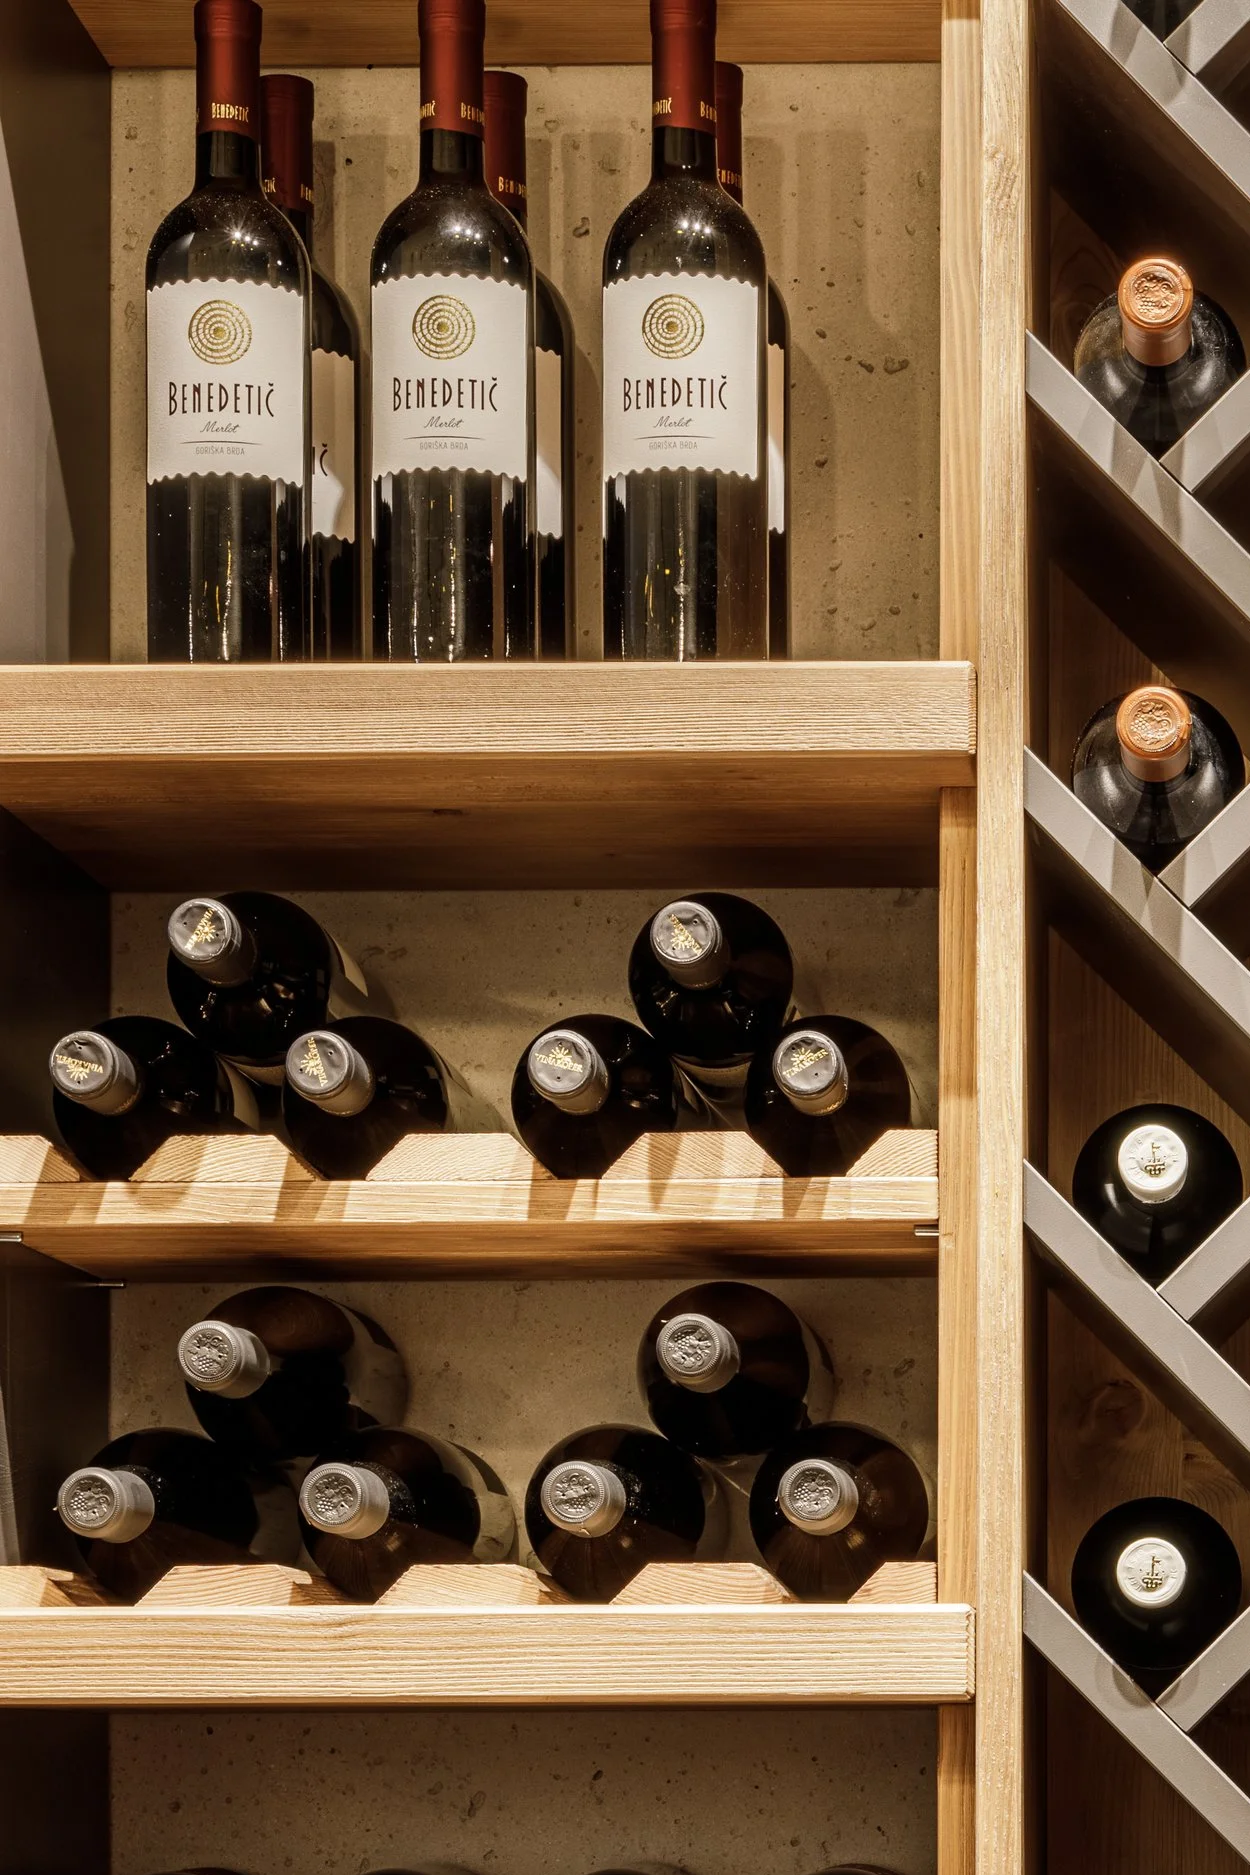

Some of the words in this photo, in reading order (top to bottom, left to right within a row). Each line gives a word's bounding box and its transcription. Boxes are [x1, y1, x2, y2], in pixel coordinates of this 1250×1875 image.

[169, 381, 275, 417] BENEDETIČ
[393, 376, 498, 412] BENEDETIČ
[623, 375, 728, 412] BENEDETIČ
[200, 420, 241, 434] Merlot
[423, 415, 465, 429] Merlot
[653, 415, 695, 428] Merlot
[195, 445, 225, 455] GORIŠKA
[226, 446, 245, 456] BRDA
[419, 440, 448, 451] GORIŠKA
[450, 442, 469, 451] BRDA
[648, 440, 678, 450] GORIŠKA
[679, 441, 698, 450] BRDA
